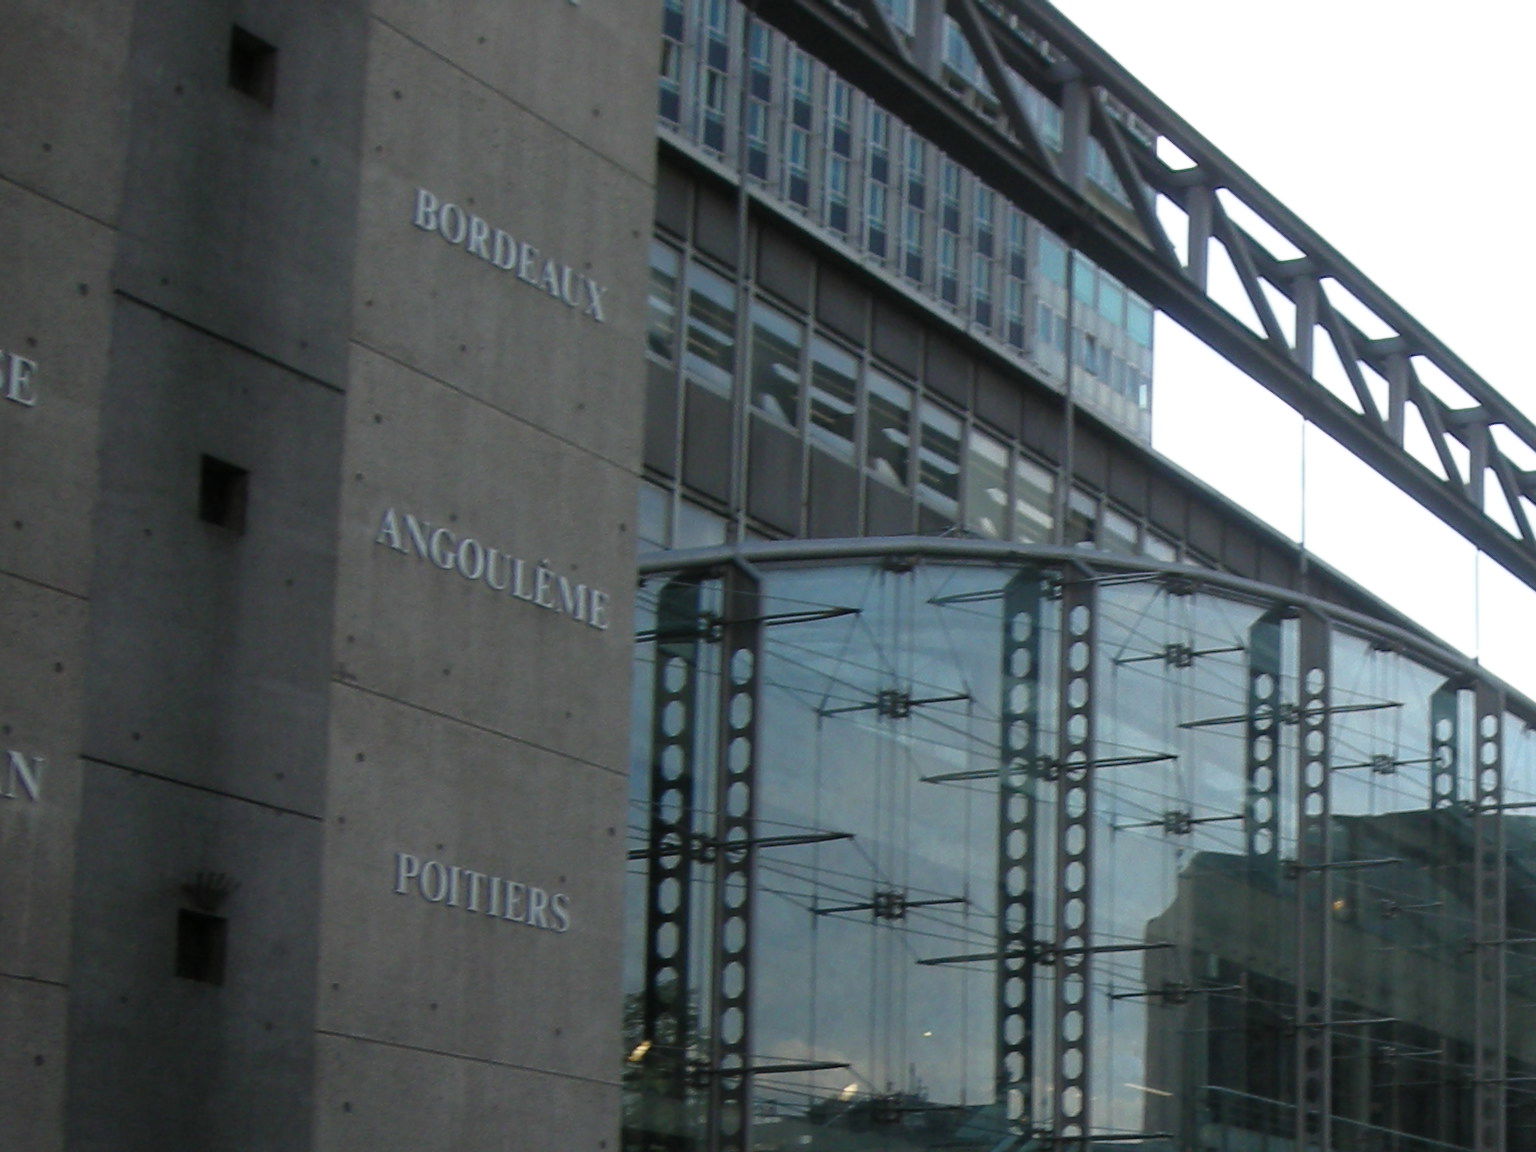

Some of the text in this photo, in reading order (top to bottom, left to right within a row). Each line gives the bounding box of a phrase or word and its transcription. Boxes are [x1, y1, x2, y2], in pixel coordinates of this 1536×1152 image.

[413, 188, 608, 322] BORDEAUX
[0, 349, 38, 408] E
[395, 851, 571, 933] POITIERS
